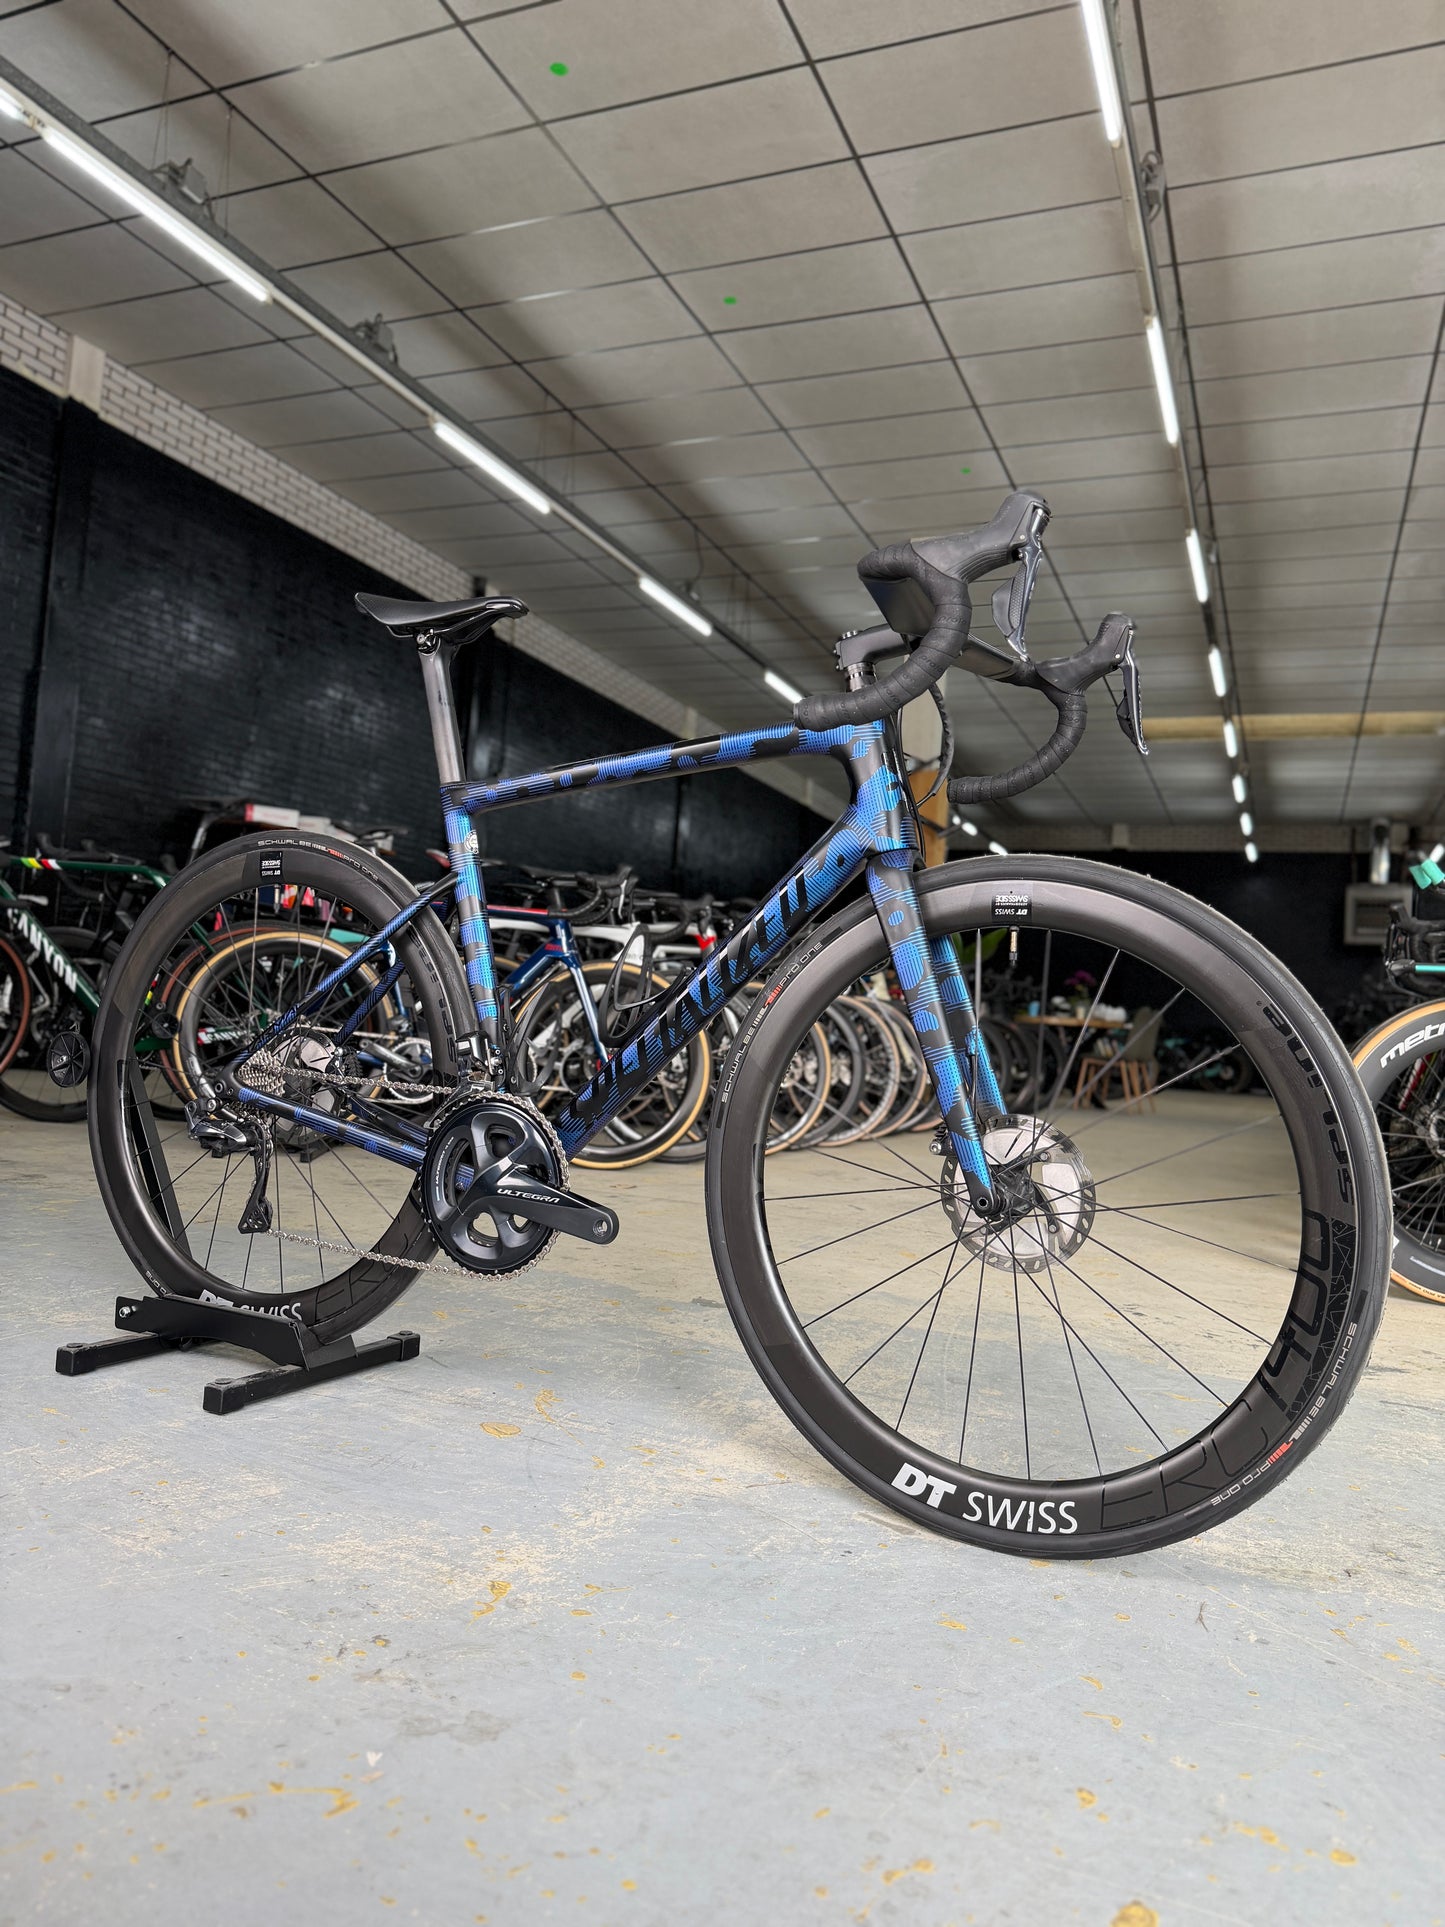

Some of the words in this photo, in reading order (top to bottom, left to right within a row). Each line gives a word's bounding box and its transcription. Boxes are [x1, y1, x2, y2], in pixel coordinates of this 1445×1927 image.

[1015, 908, 1028, 916] DT
[721, 1027, 755, 1103] SCHWALBE
[496, 1188, 561, 1204] ULTEGRA
[1309, 1322, 1358, 1418] SCHWALBE
[891, 1462, 957, 1509] DT
[962, 1491, 1078, 1534] SWISS
